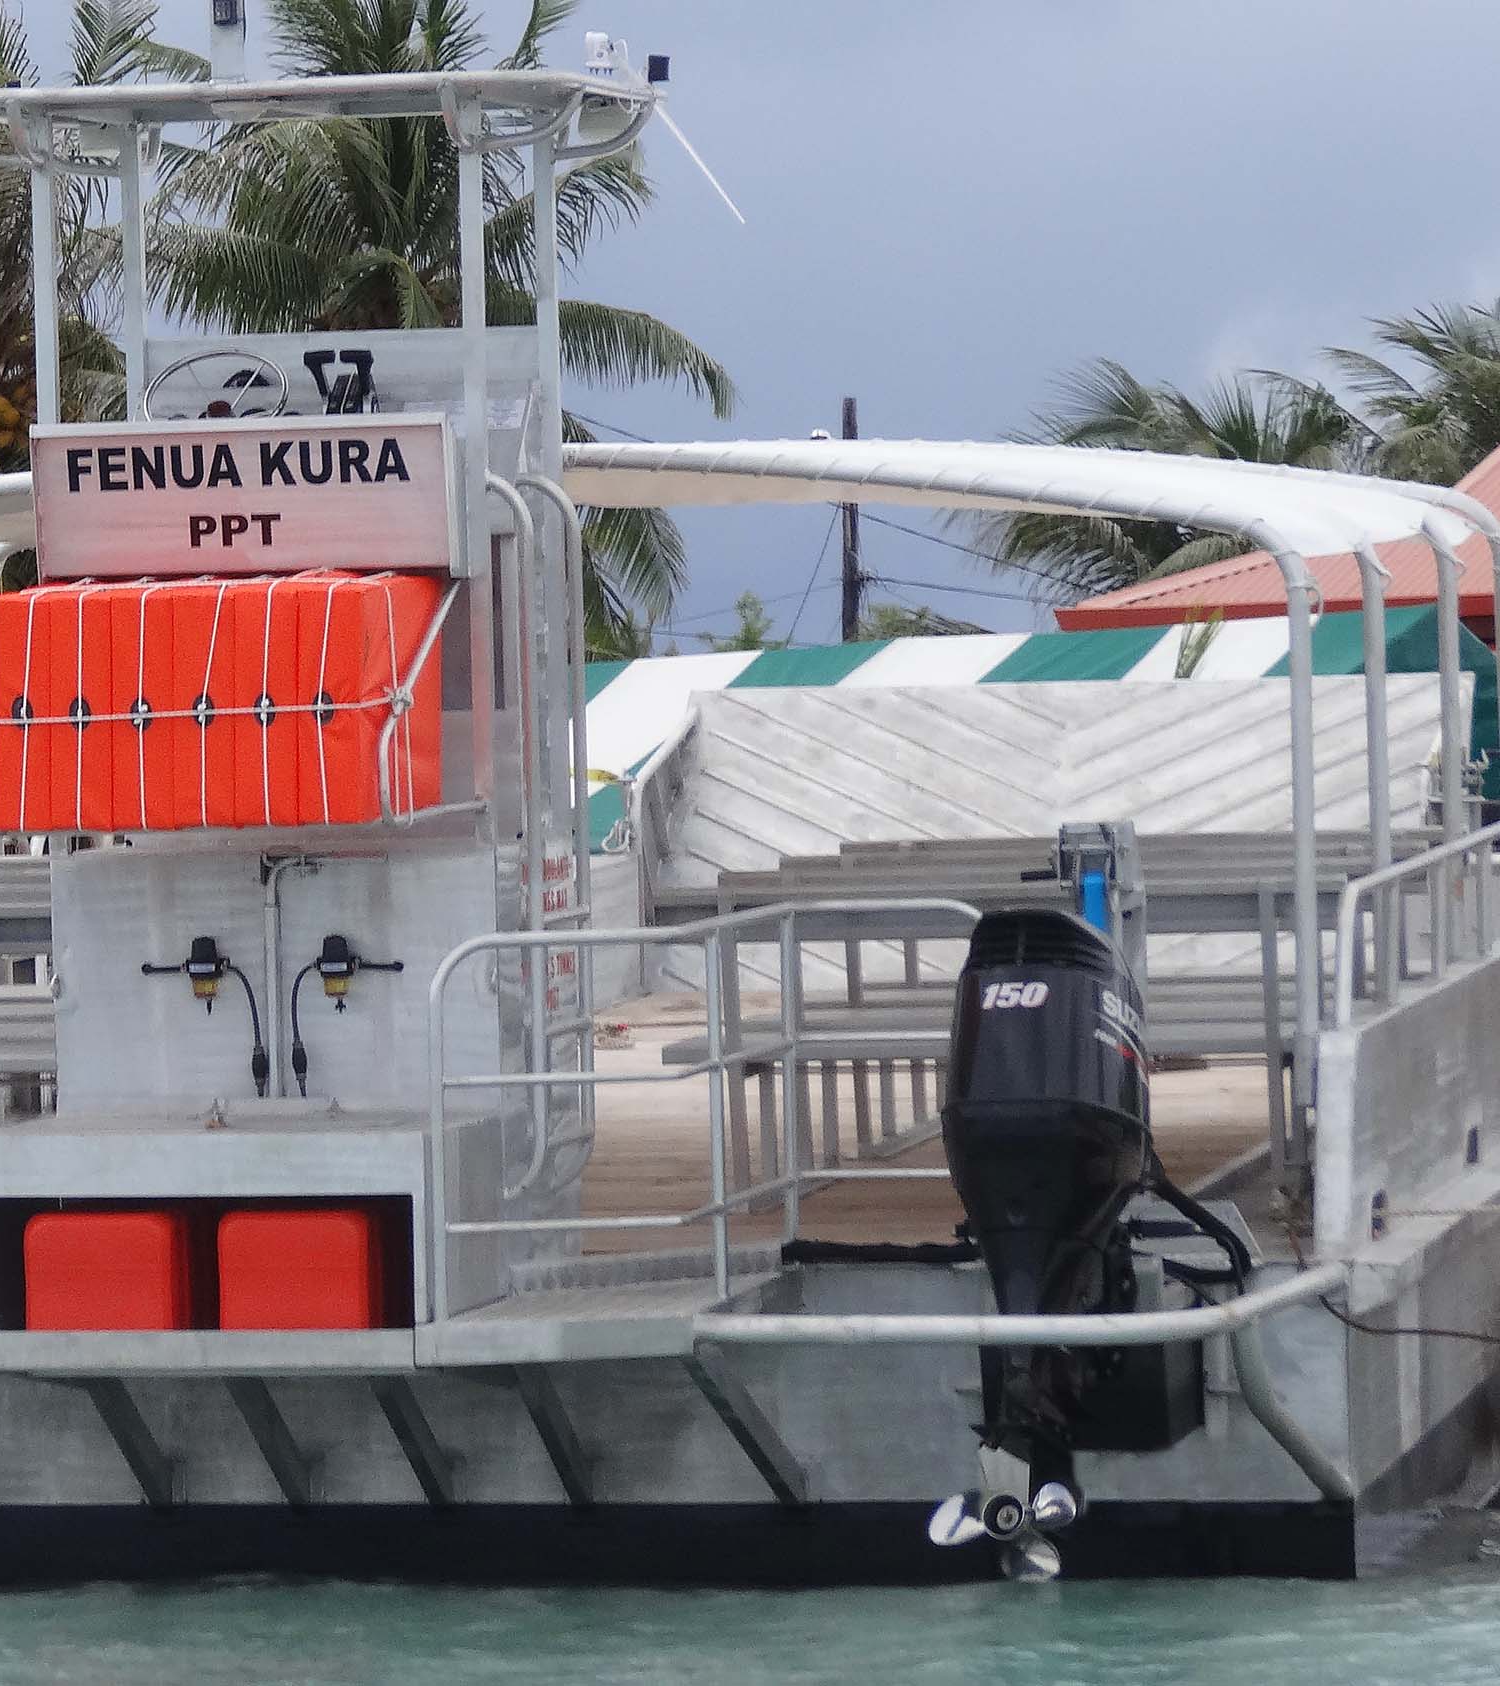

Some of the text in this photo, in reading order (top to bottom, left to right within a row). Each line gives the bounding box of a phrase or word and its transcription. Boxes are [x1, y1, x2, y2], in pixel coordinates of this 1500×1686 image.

[67, 438, 411, 492] FENUA KURA
[189, 513, 281, 548] PPT
[982, 981, 1051, 1010] 150
